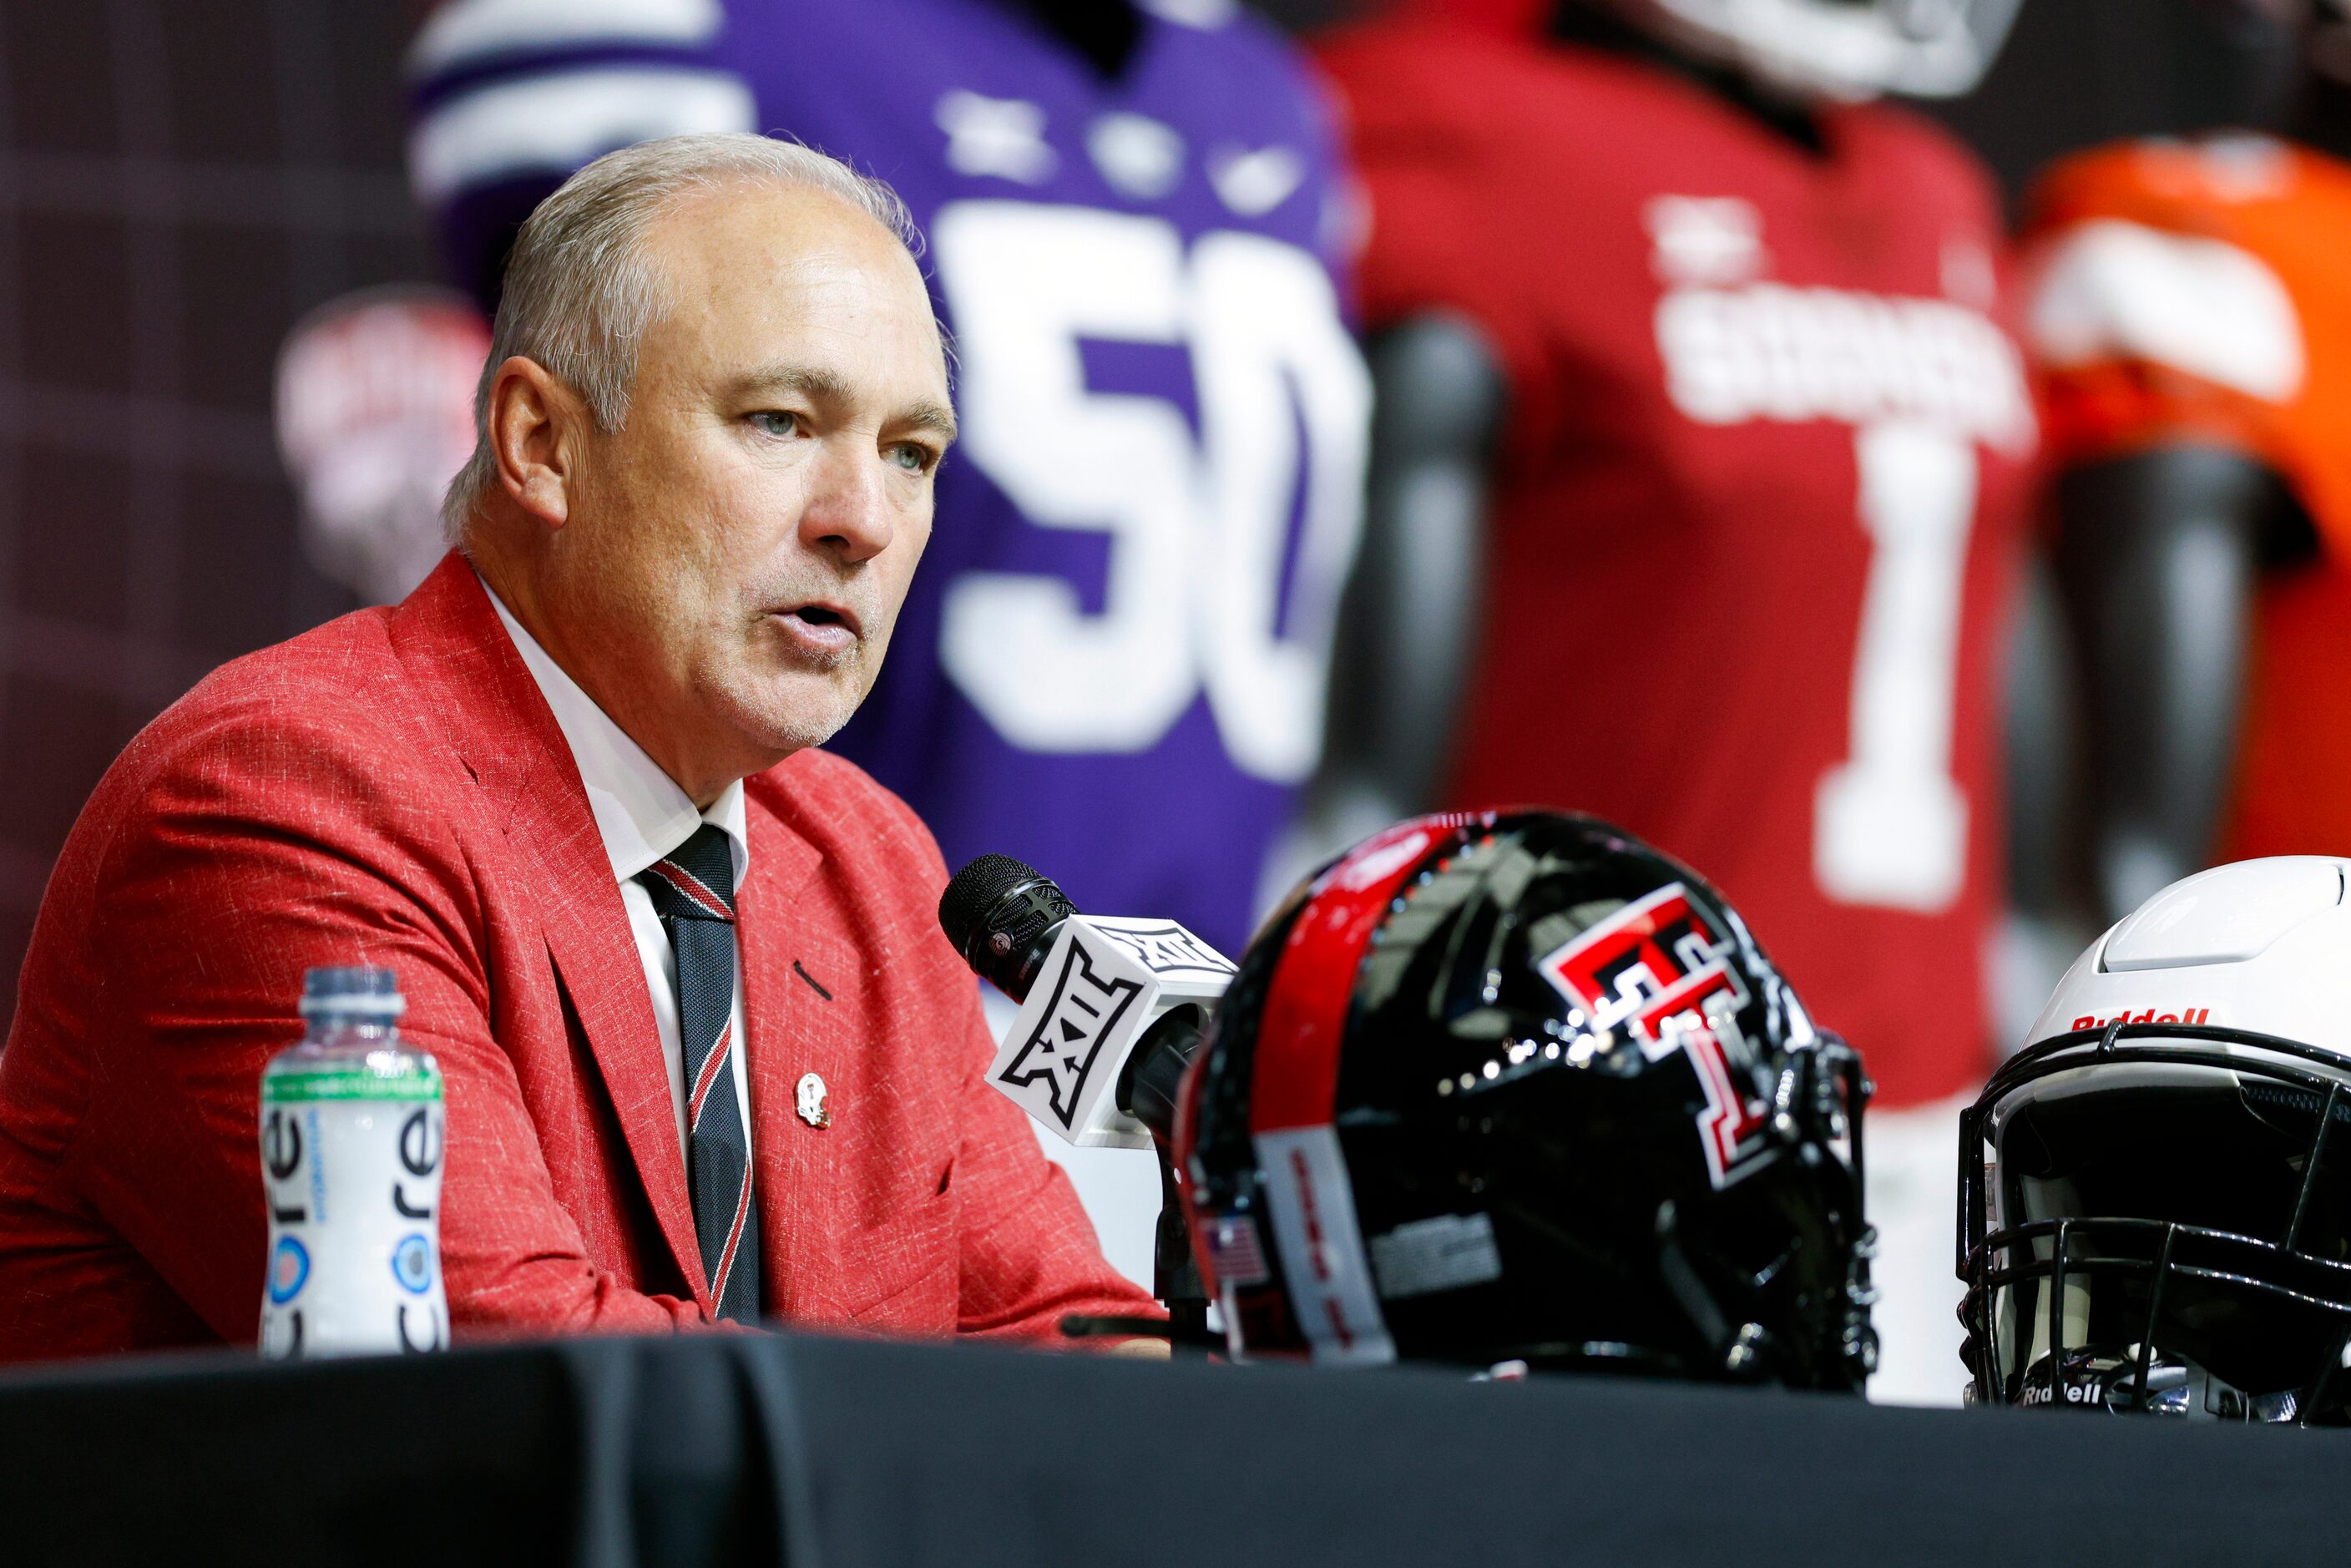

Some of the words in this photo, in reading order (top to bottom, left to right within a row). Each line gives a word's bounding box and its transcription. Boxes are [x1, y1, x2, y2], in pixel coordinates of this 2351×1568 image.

[935, 197, 1373, 783] 50
[1812, 416, 1979, 912] 1
[2023, 1383, 2101, 1407] Ridell
